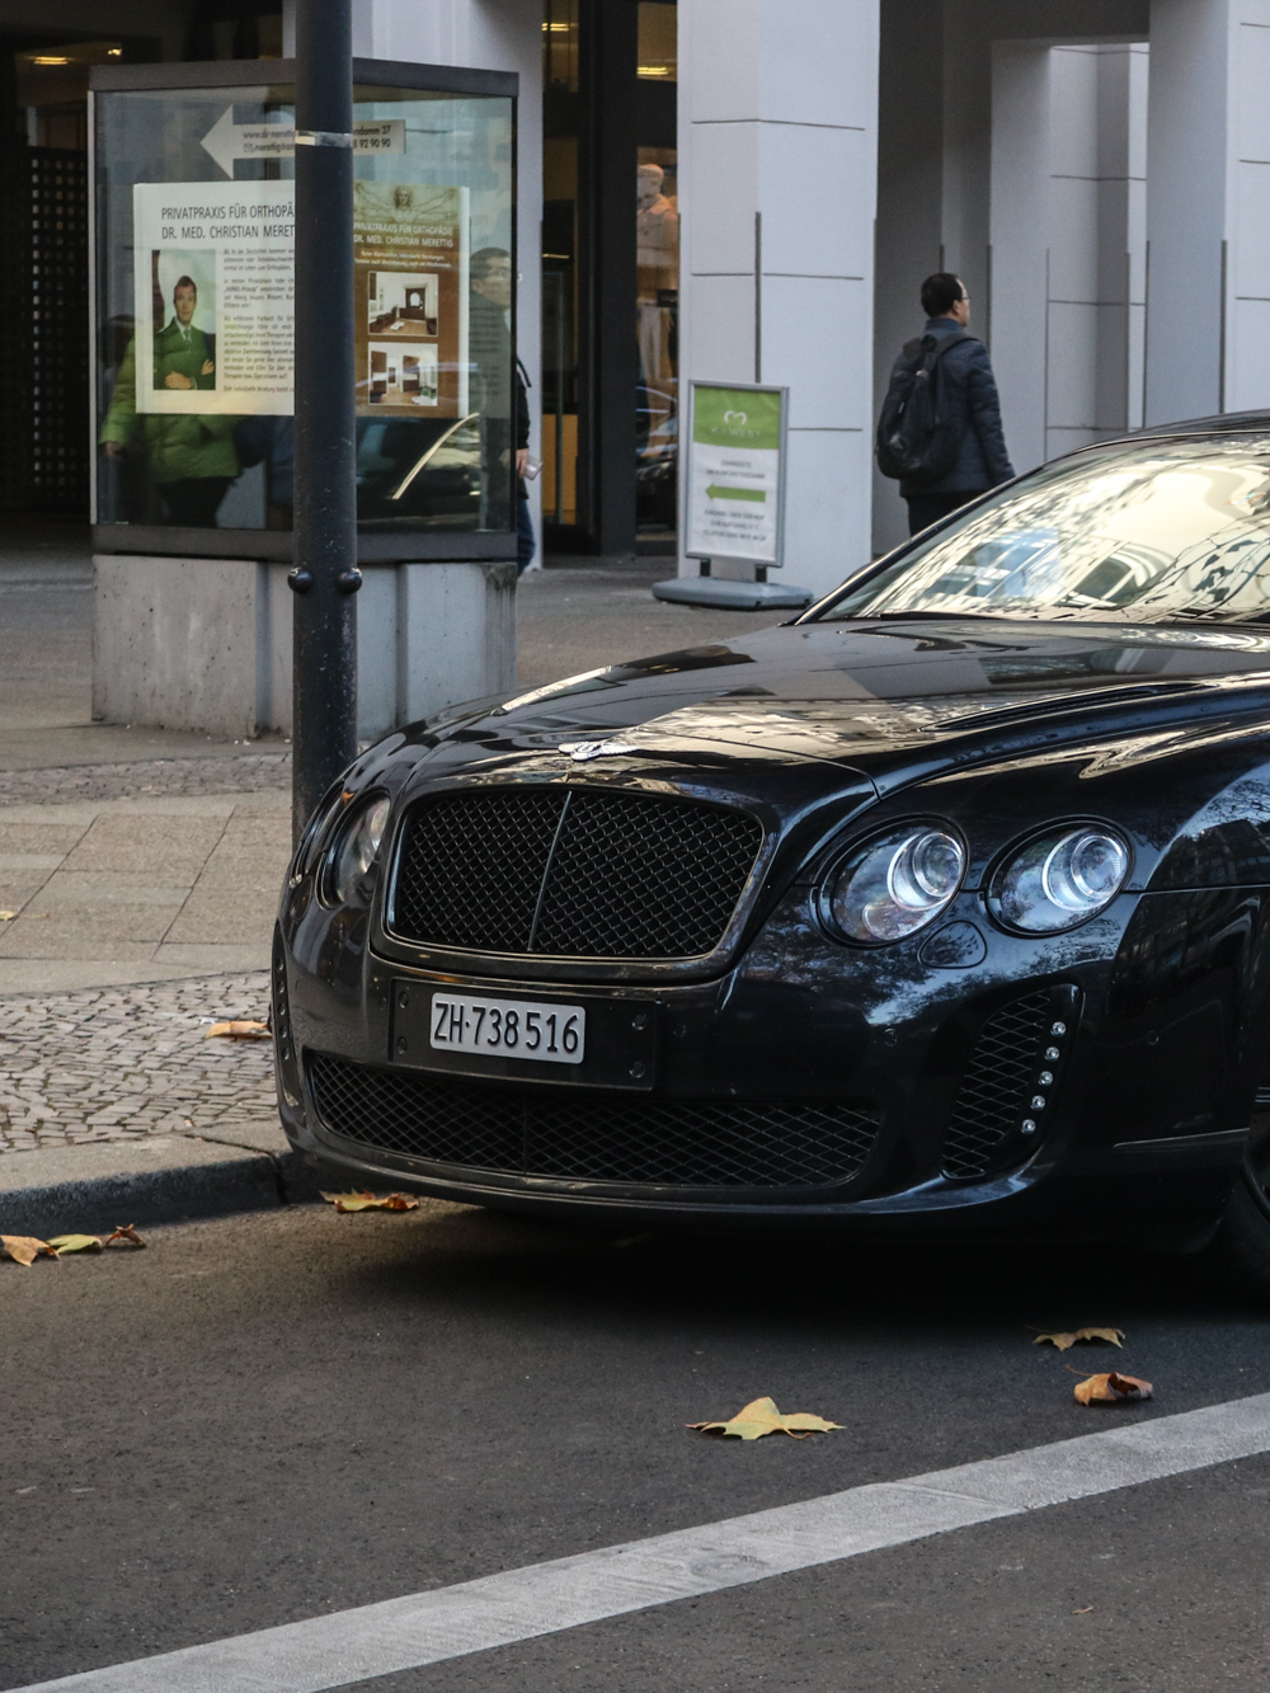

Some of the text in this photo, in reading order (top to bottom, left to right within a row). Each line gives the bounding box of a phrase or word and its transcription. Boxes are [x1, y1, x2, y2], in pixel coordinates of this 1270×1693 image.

[382, 125, 391, 134] 37
[359, 138, 368, 148] 92
[370, 138, 380, 148] 90
[381, 138, 391, 148] 90
[161, 202, 294, 220] PRIVATPRAXIS FÜR ORTHOPÄ
[162, 224, 294, 239] DR. MED. CHRISTIAN MERET
